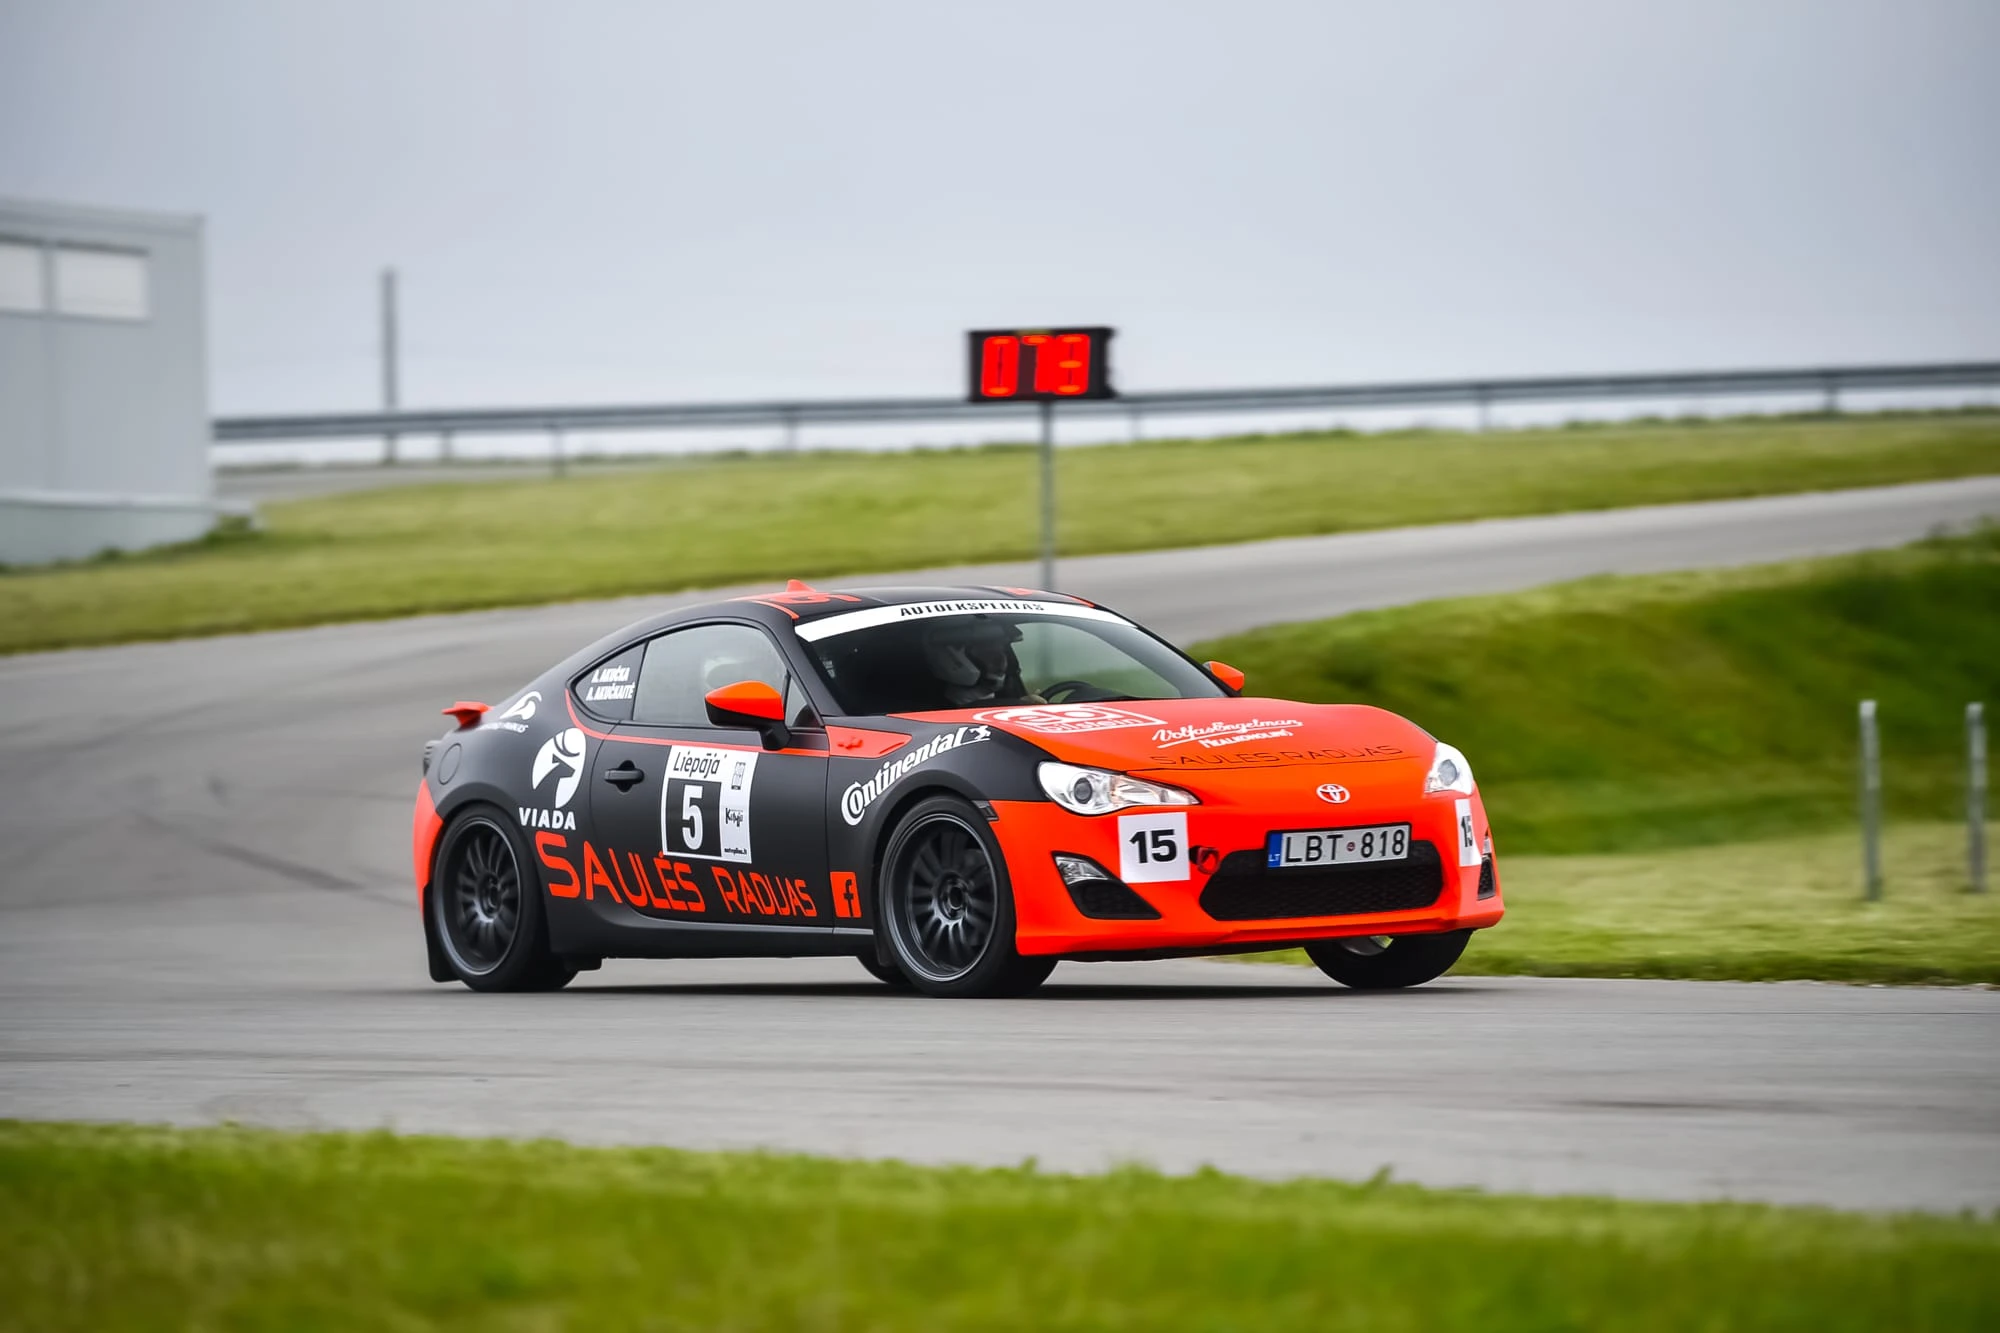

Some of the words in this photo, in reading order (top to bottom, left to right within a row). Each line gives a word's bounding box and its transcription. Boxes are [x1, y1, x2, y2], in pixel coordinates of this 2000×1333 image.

[841, 726, 969, 826] Continental
[518, 807, 576, 831] VIADA
[682, 784, 704, 850] 5
[1129, 828, 1177, 864] 15
[1285, 834, 1343, 863] LBT
[1361, 829, 1405, 858] 818
